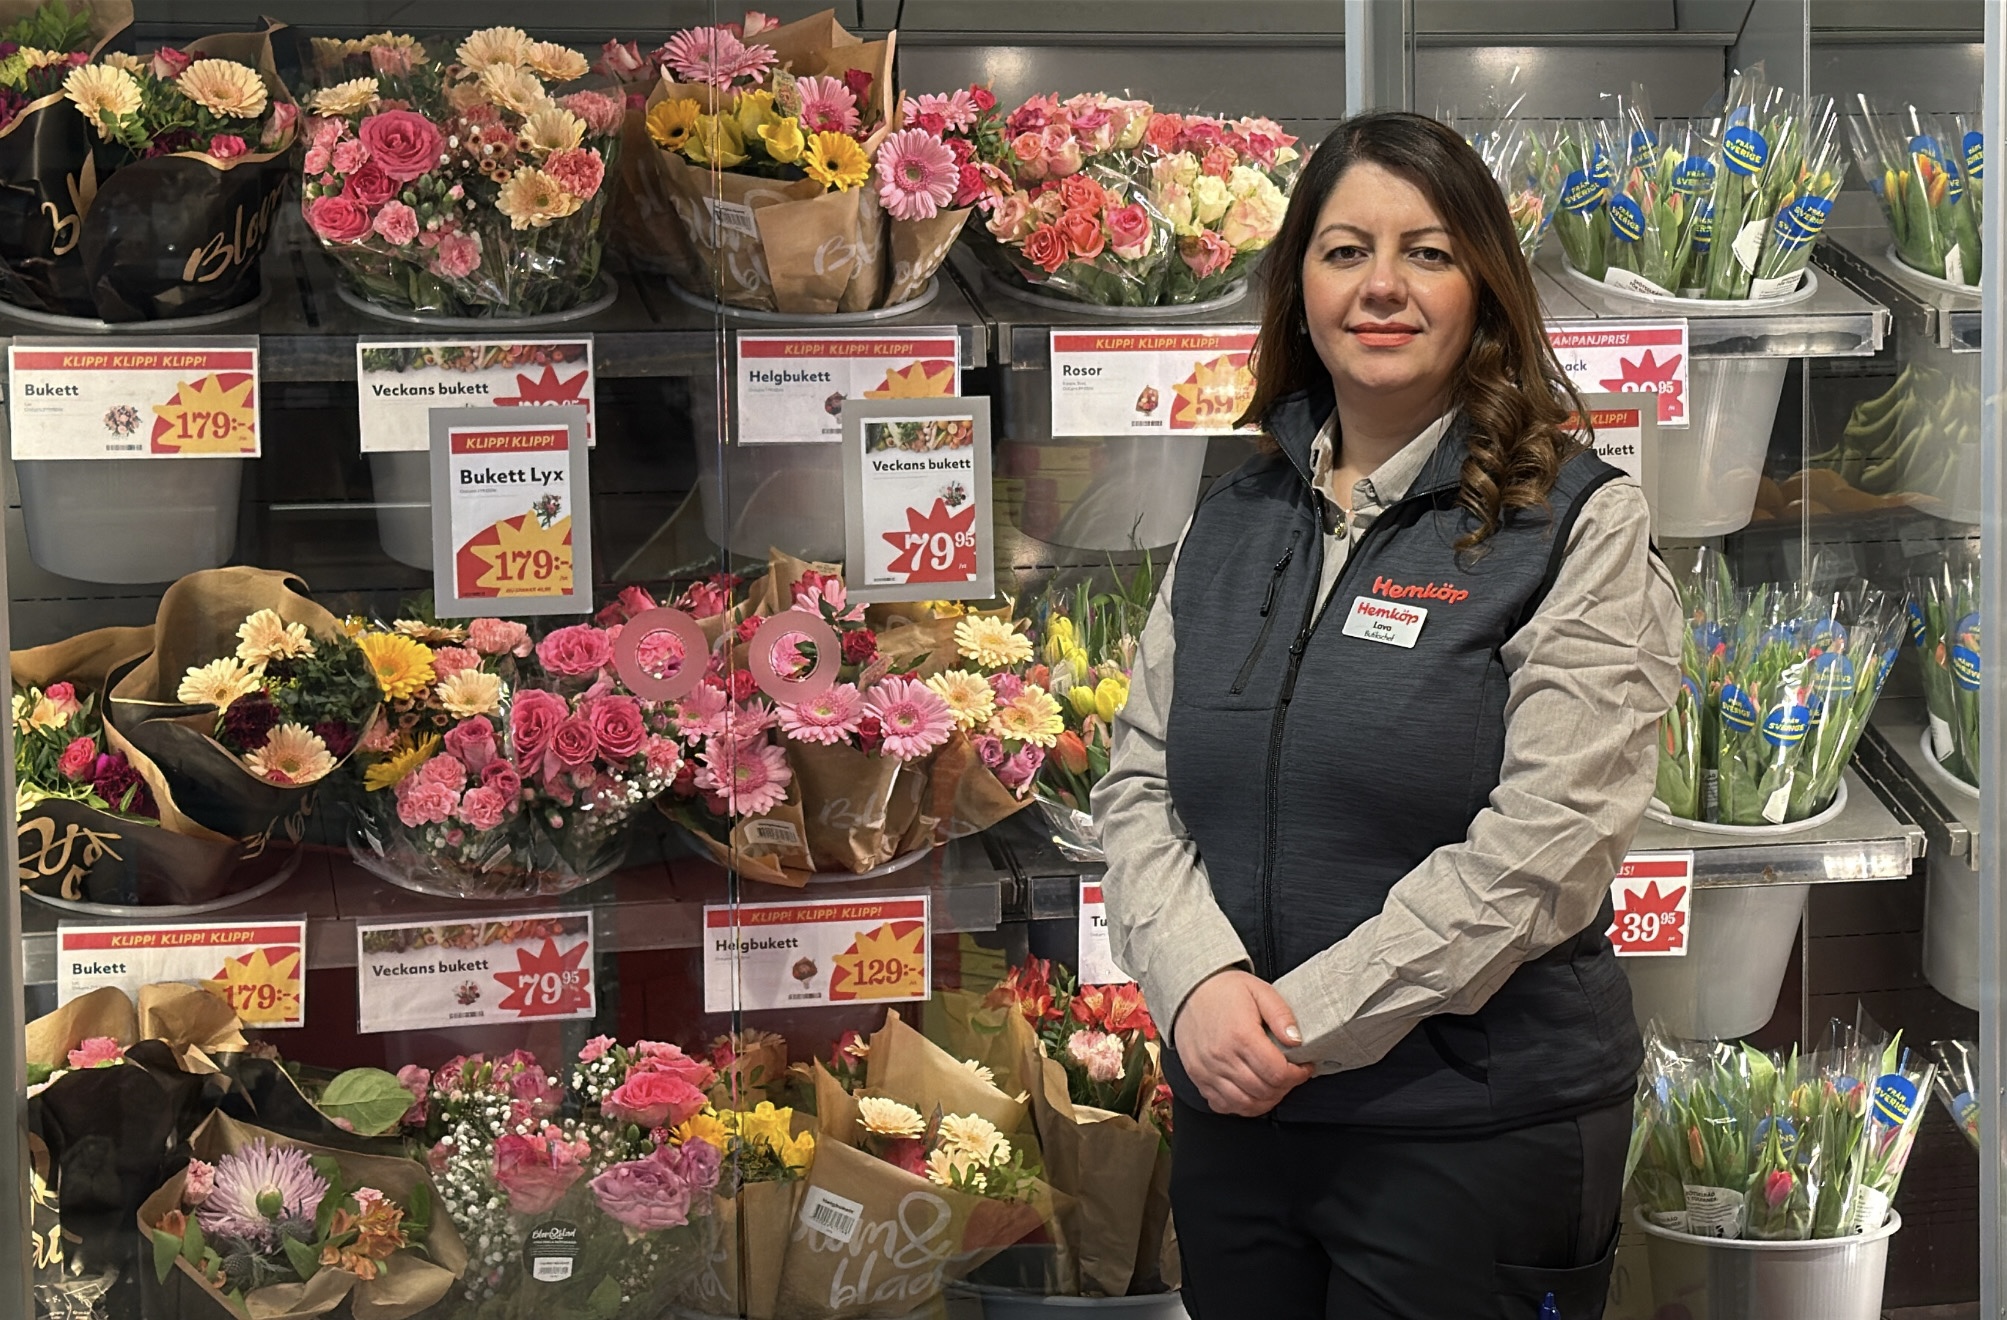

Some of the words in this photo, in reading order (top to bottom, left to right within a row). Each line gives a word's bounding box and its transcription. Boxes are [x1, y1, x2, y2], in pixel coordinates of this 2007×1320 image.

[1725, 140, 1762, 163] SVERIGE
[1735, 138, 1755, 152] FRÅN
[784, 344, 824, 355] KLIPP!
[829, 344, 869, 355] KLIPP!
[873, 343, 913, 354] KLIPP!
[1096, 338, 1135, 349] KLIPP!
[1138, 338, 1177, 349] KLIPP!
[1181, 337, 1219, 348] KLIPP!
[63, 356, 108, 367] KLIPP!
[113, 355, 158, 367] KLIPP!
[163, 355, 207, 366] KLIPP!
[749, 370, 831, 385] Helgbukett
[1062, 365, 1102, 376] Rosor
[24, 383, 79, 396] Bukett
[372, 384, 435, 396] Veckans
[438, 382, 489, 395] bukett
[176, 411, 246, 439] 179:-
[1591, 413, 1627, 424] KLIPP!
[466, 437, 509, 449] KLIPP!
[511, 435, 554, 447] KLIPP!
[1597, 444, 1634, 456] ukett
[872, 460, 926, 471] Veckans
[928, 458, 971, 470] bukett
[460, 468, 526, 484] Bukett
[531, 467, 563, 486] Lyx
[1372, 575, 1469, 604] Hemköp
[1357, 601, 1419, 626] Hemköp
[1768, 722, 1805, 731] SVERIGE
[751, 911, 792, 923] KLIPP!
[797, 909, 837, 921] KLIPP!
[842, 906, 882, 918] KLIPP!
[111, 935, 155, 946] KLIPP!
[161, 933, 205, 945] KLIPP!
[210, 932, 254, 943] KLIPP!
[715, 937, 798, 953] Helgbukett
[72, 962, 126, 975] Bukett
[372, 964, 435, 977] Veckans
[438, 959, 489, 973] bukett
[853, 958, 917, 986] 129:-
[1875, 1087, 1910, 1115] SVERIGE
[1887, 1086, 1906, 1103] FRÅN
